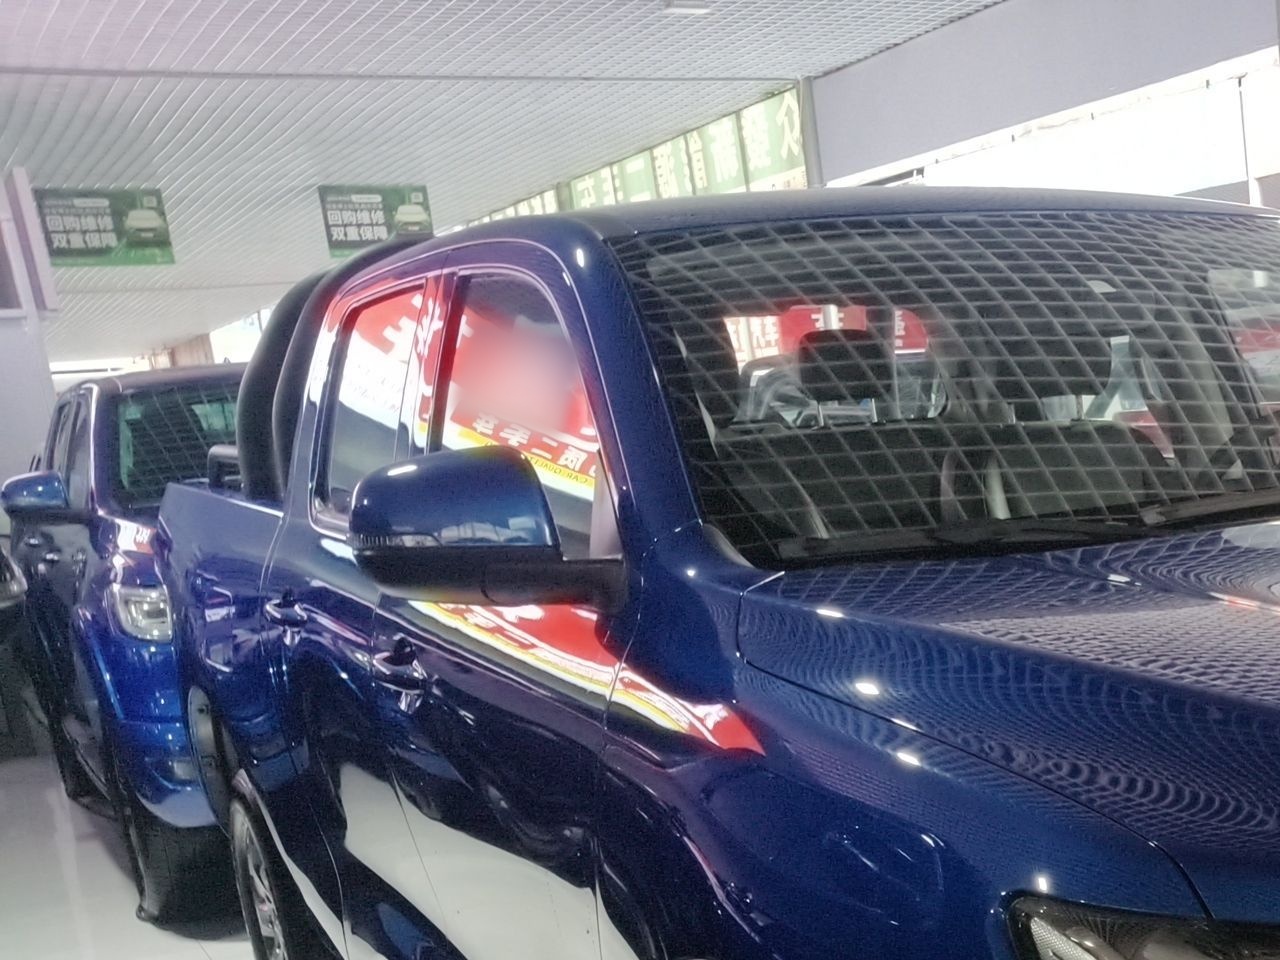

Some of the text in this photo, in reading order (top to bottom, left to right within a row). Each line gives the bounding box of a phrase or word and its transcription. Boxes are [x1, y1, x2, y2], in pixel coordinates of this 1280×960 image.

[45, 215, 114, 231] 回购维修
[327, 209, 385, 224] 回购维修
[50, 231, 118, 249] 双重保障
[330, 225, 389, 241] 双重保障
